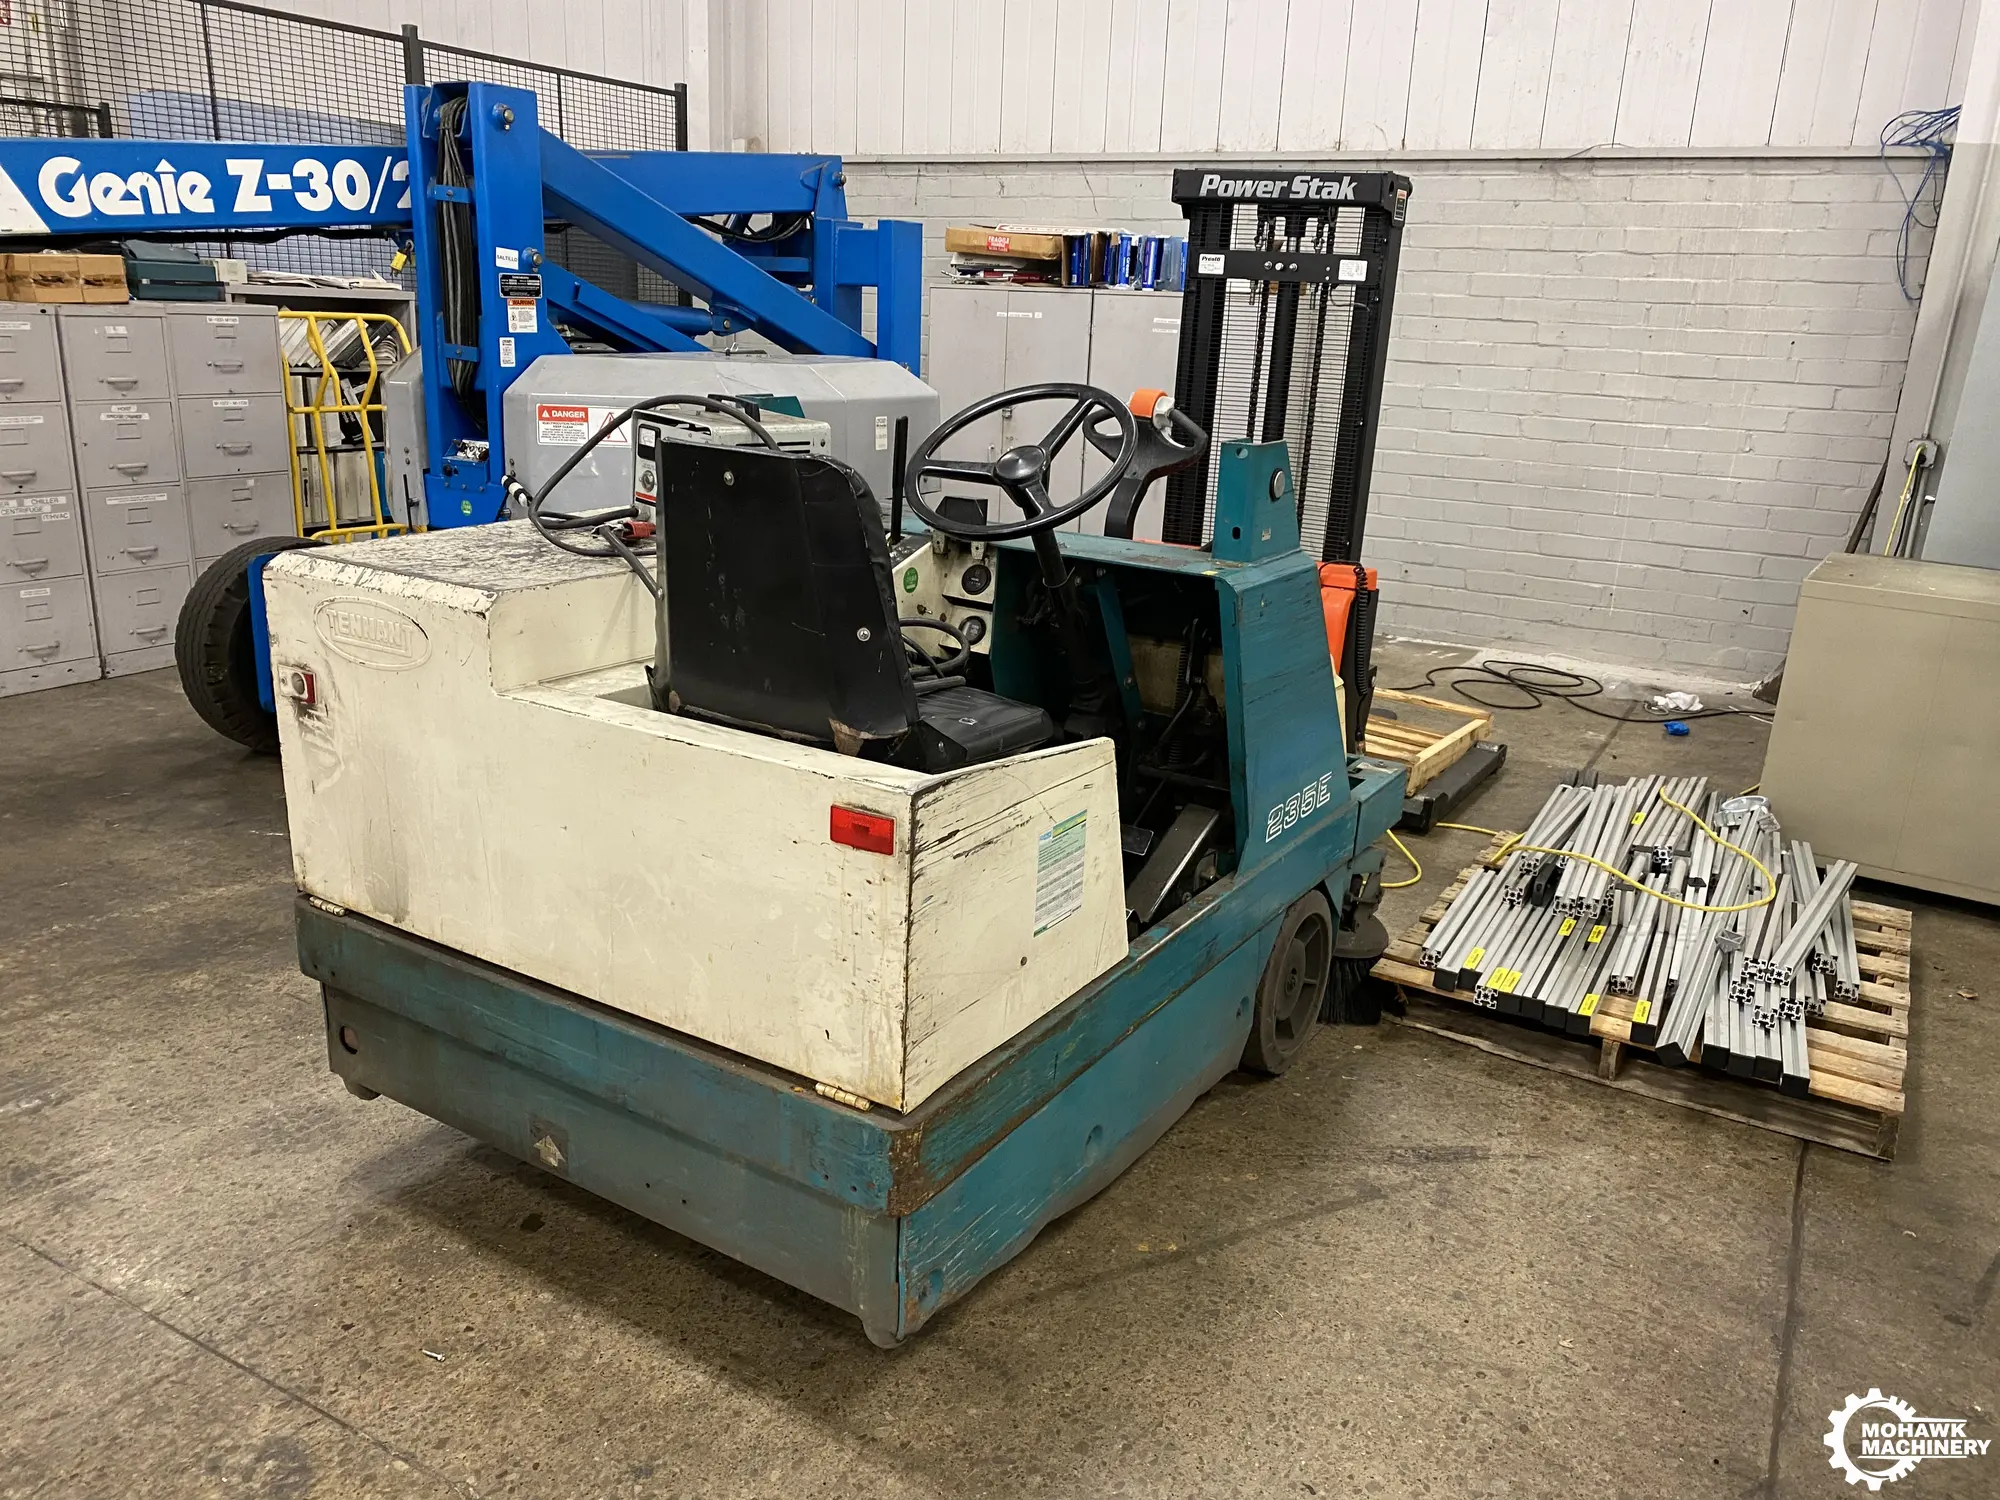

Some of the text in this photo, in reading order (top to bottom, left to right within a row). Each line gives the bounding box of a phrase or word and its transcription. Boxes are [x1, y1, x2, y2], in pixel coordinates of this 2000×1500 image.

[38, 156, 215, 218] Genie
[1200, 174, 1358, 200] Power Stak
[552, 410, 586, 418] DANGER
[325, 608, 413, 648] TENNANT
[1265, 770, 1333, 844] 235E
